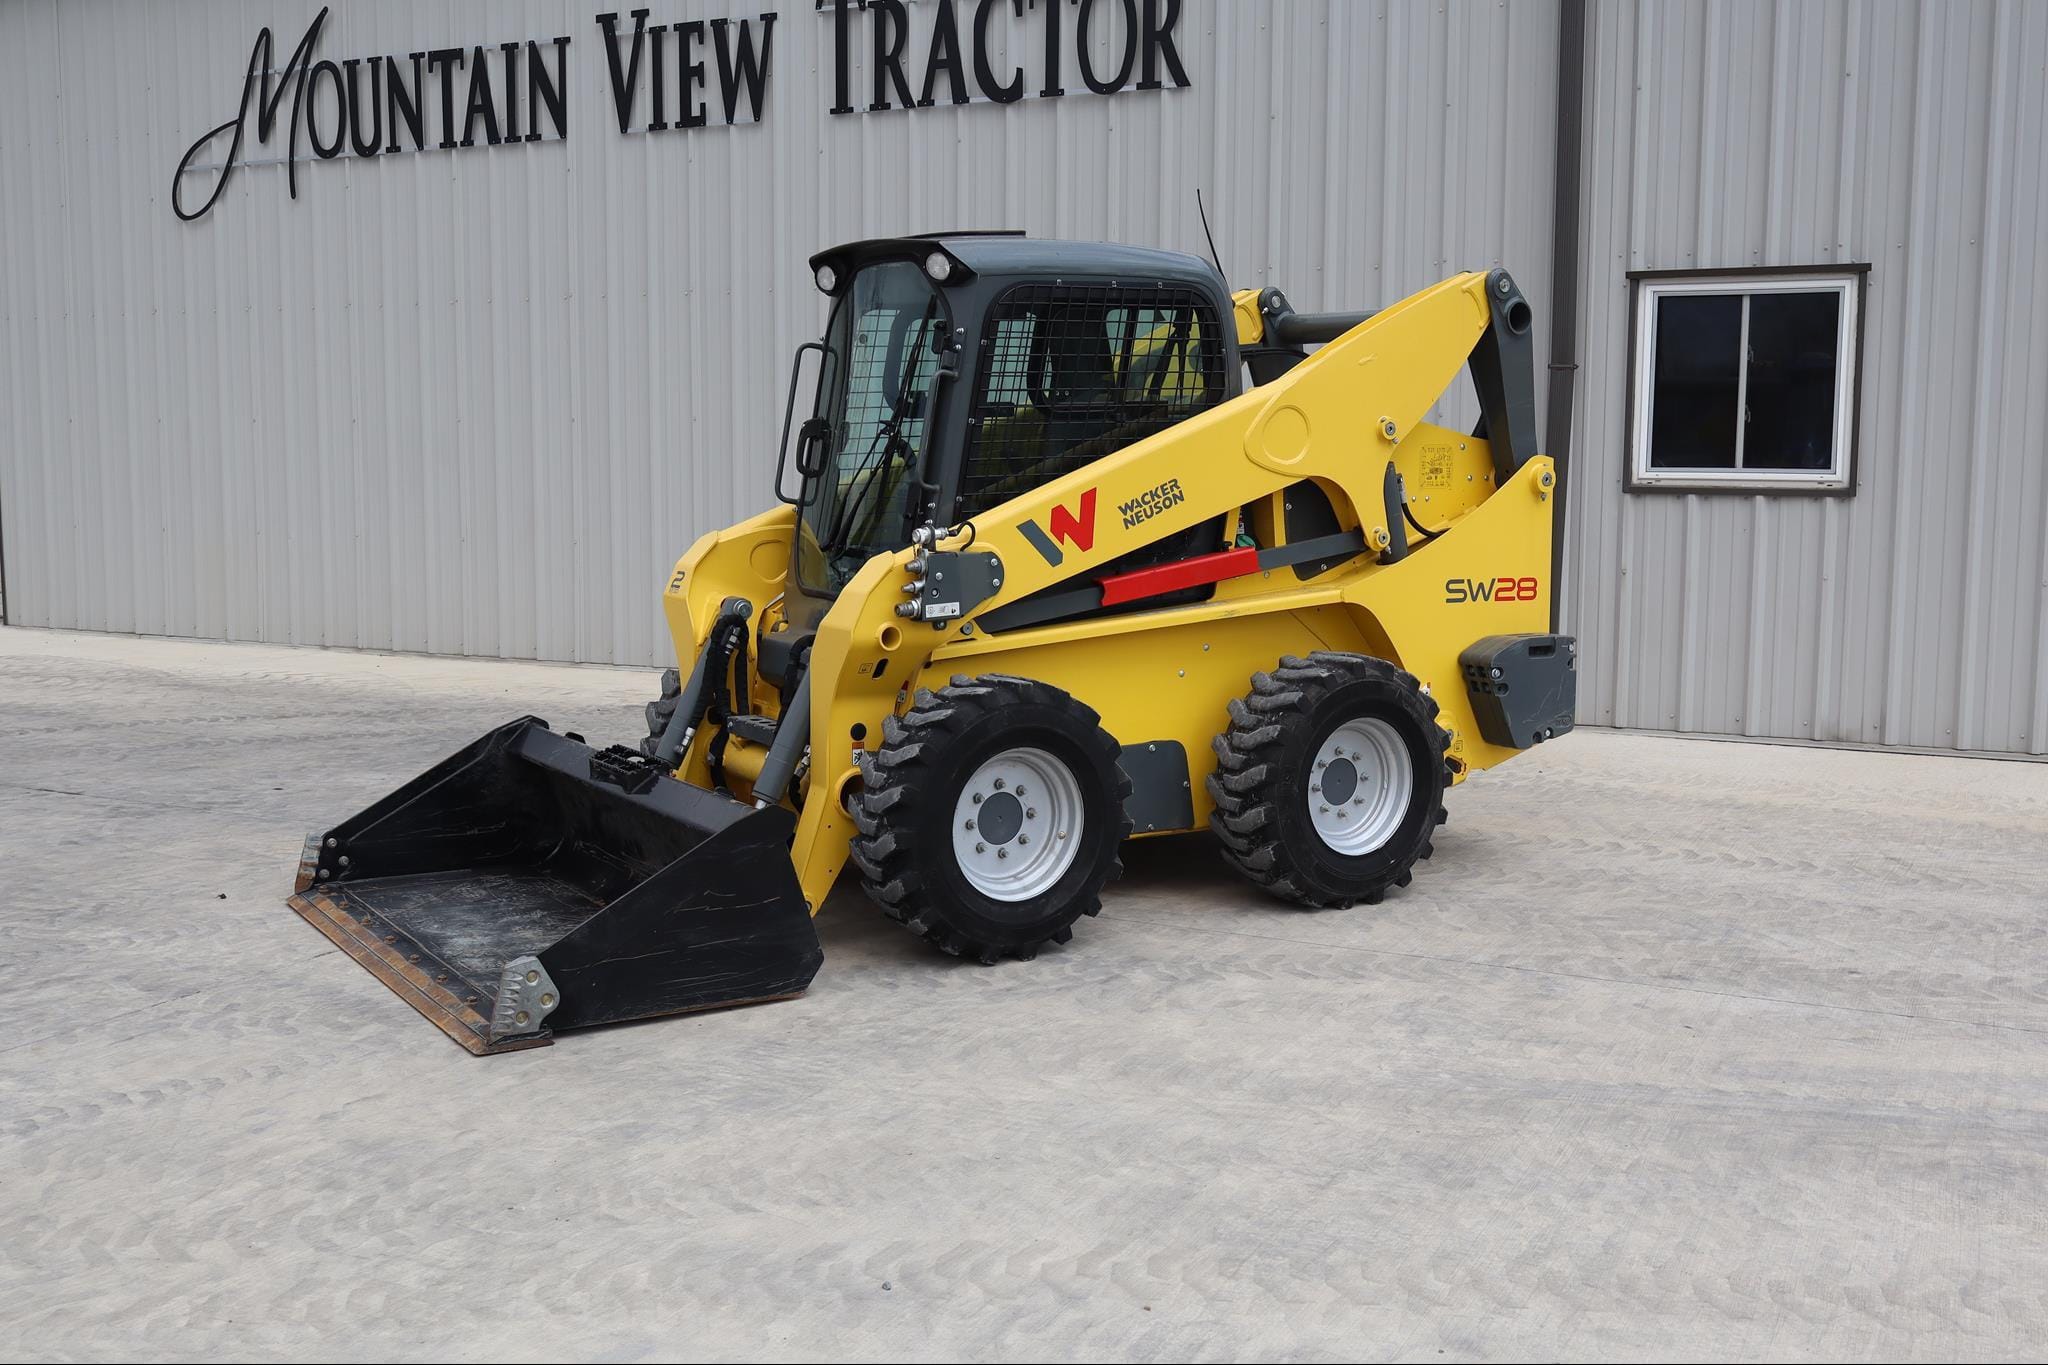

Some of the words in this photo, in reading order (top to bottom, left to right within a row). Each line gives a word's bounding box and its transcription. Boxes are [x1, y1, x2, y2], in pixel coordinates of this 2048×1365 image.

[172, 6, 571, 220] MOUNTAIN
[596, 8, 778, 133] VIEW
[815, 0, 1191, 114] TRACTOR
[1117, 478, 1181, 516] WACKER
[1123, 490, 1185, 530] NEUSON
[1445, 577, 1538, 603] SW28
